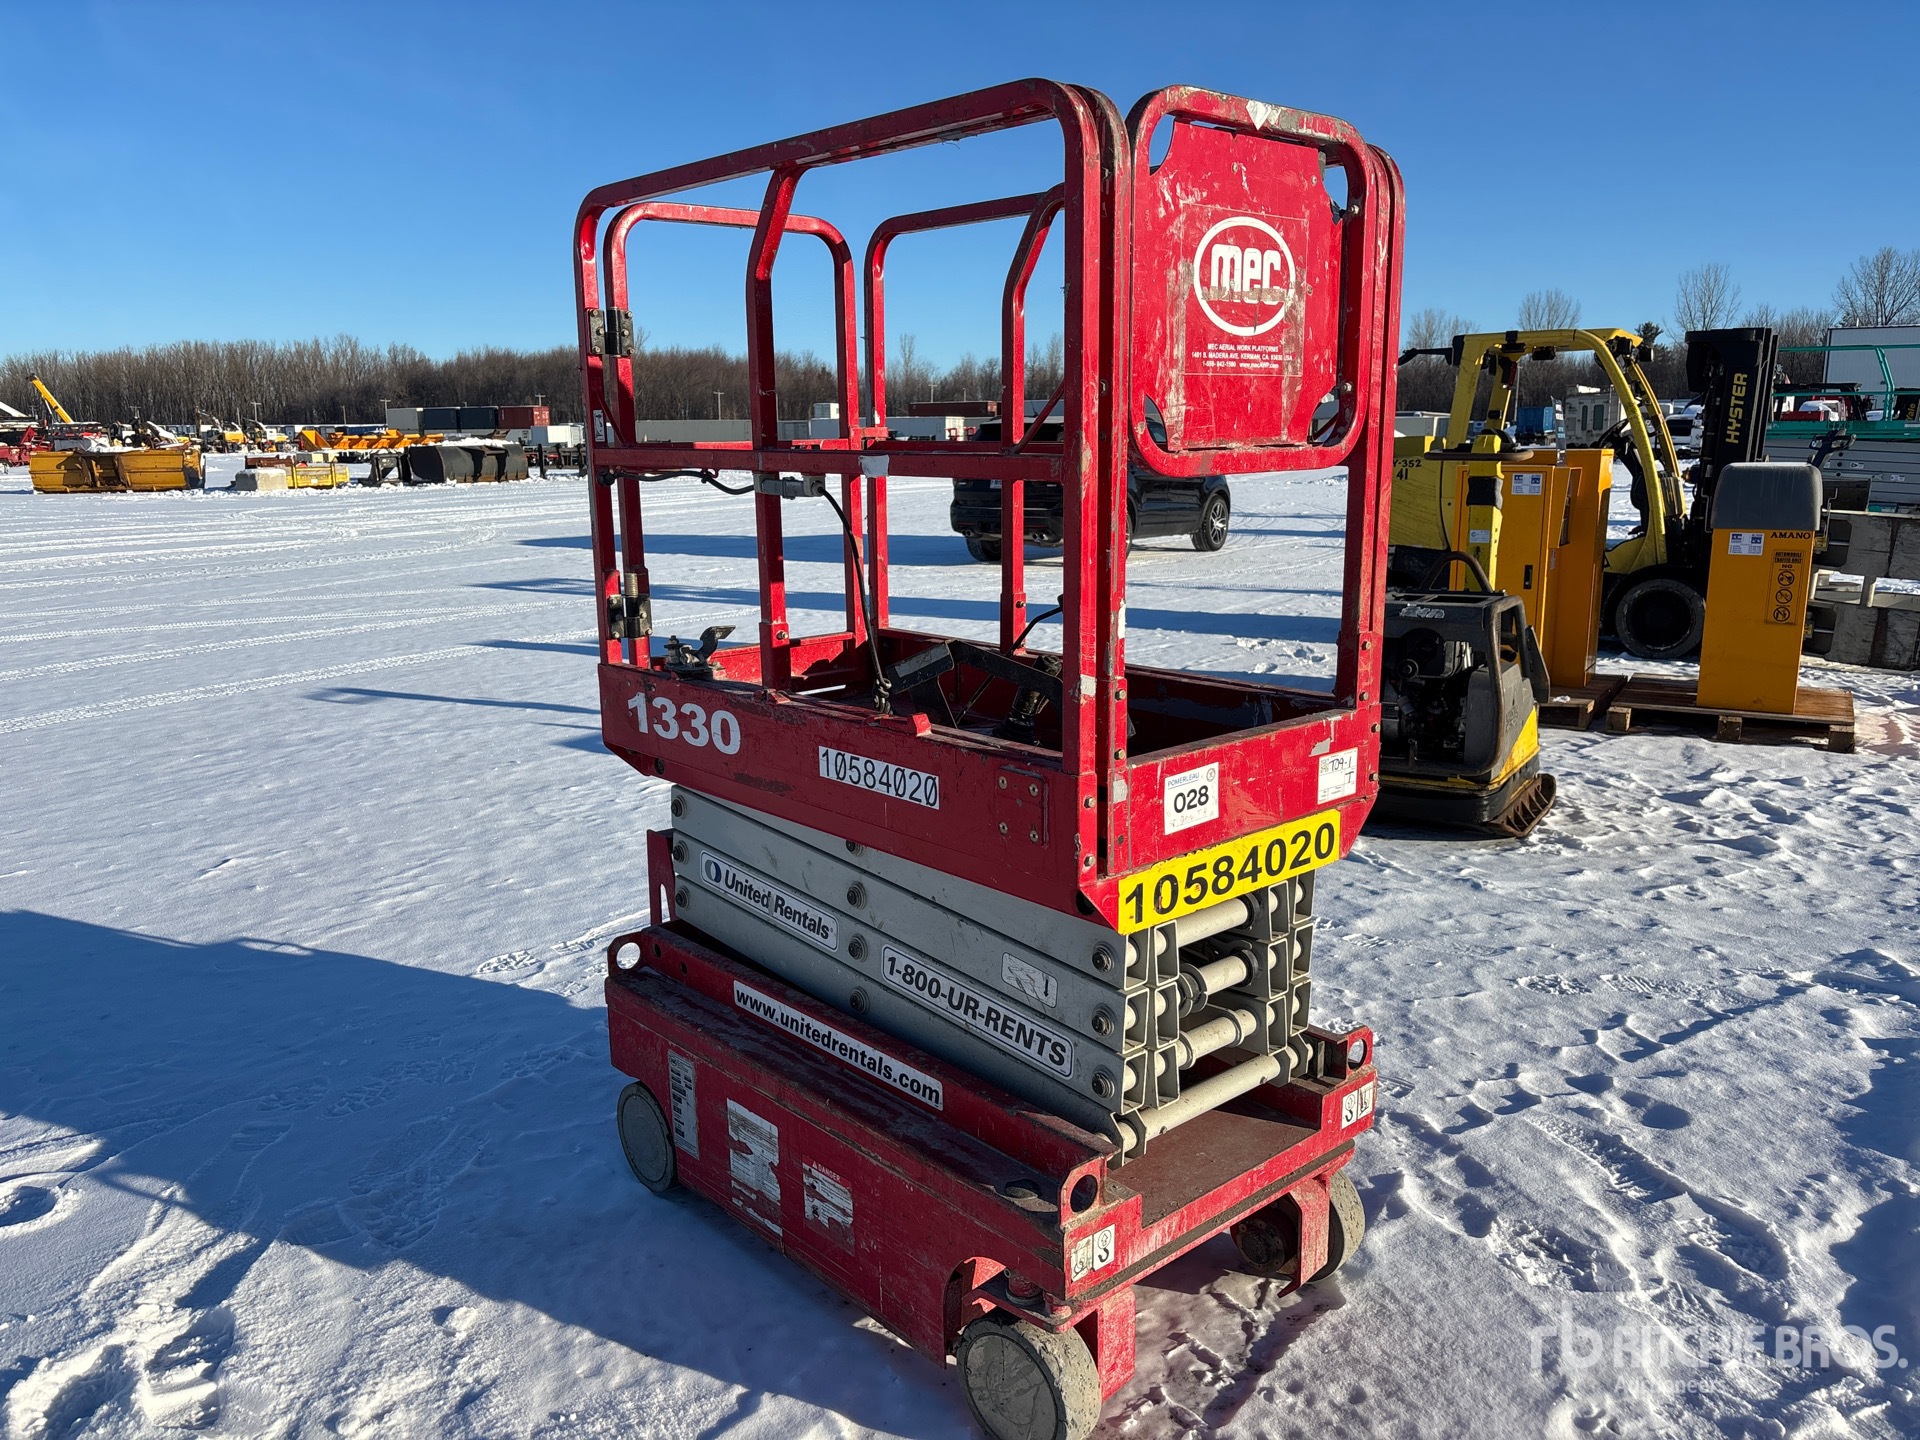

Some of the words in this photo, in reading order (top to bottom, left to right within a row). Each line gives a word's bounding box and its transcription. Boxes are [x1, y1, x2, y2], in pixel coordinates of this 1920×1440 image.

[1219, 343, 1236, 351] AERIAL
[1236, 344, 1251, 352] WORK
[1725, 372, 1748, 444] HYSTER
[1396, 468, 1408, 480] 41
[1770, 532, 1811, 540] AMANO
[627, 691, 742, 756] 1330
[820, 748, 940, 808] 10584020
[1167, 772, 1200, 787] POMERLEAU
[1173, 785, 1209, 814] 028
[1125, 822, 1335, 925] 10584020
[724, 867, 770, 908] United
[773, 892, 831, 941] Rentals
[886, 955, 1067, 1068] 1-800-UR-RENTS
[736, 990, 941, 1107] www.unitedrentals.com
[817, 1163, 841, 1183] DANGER
